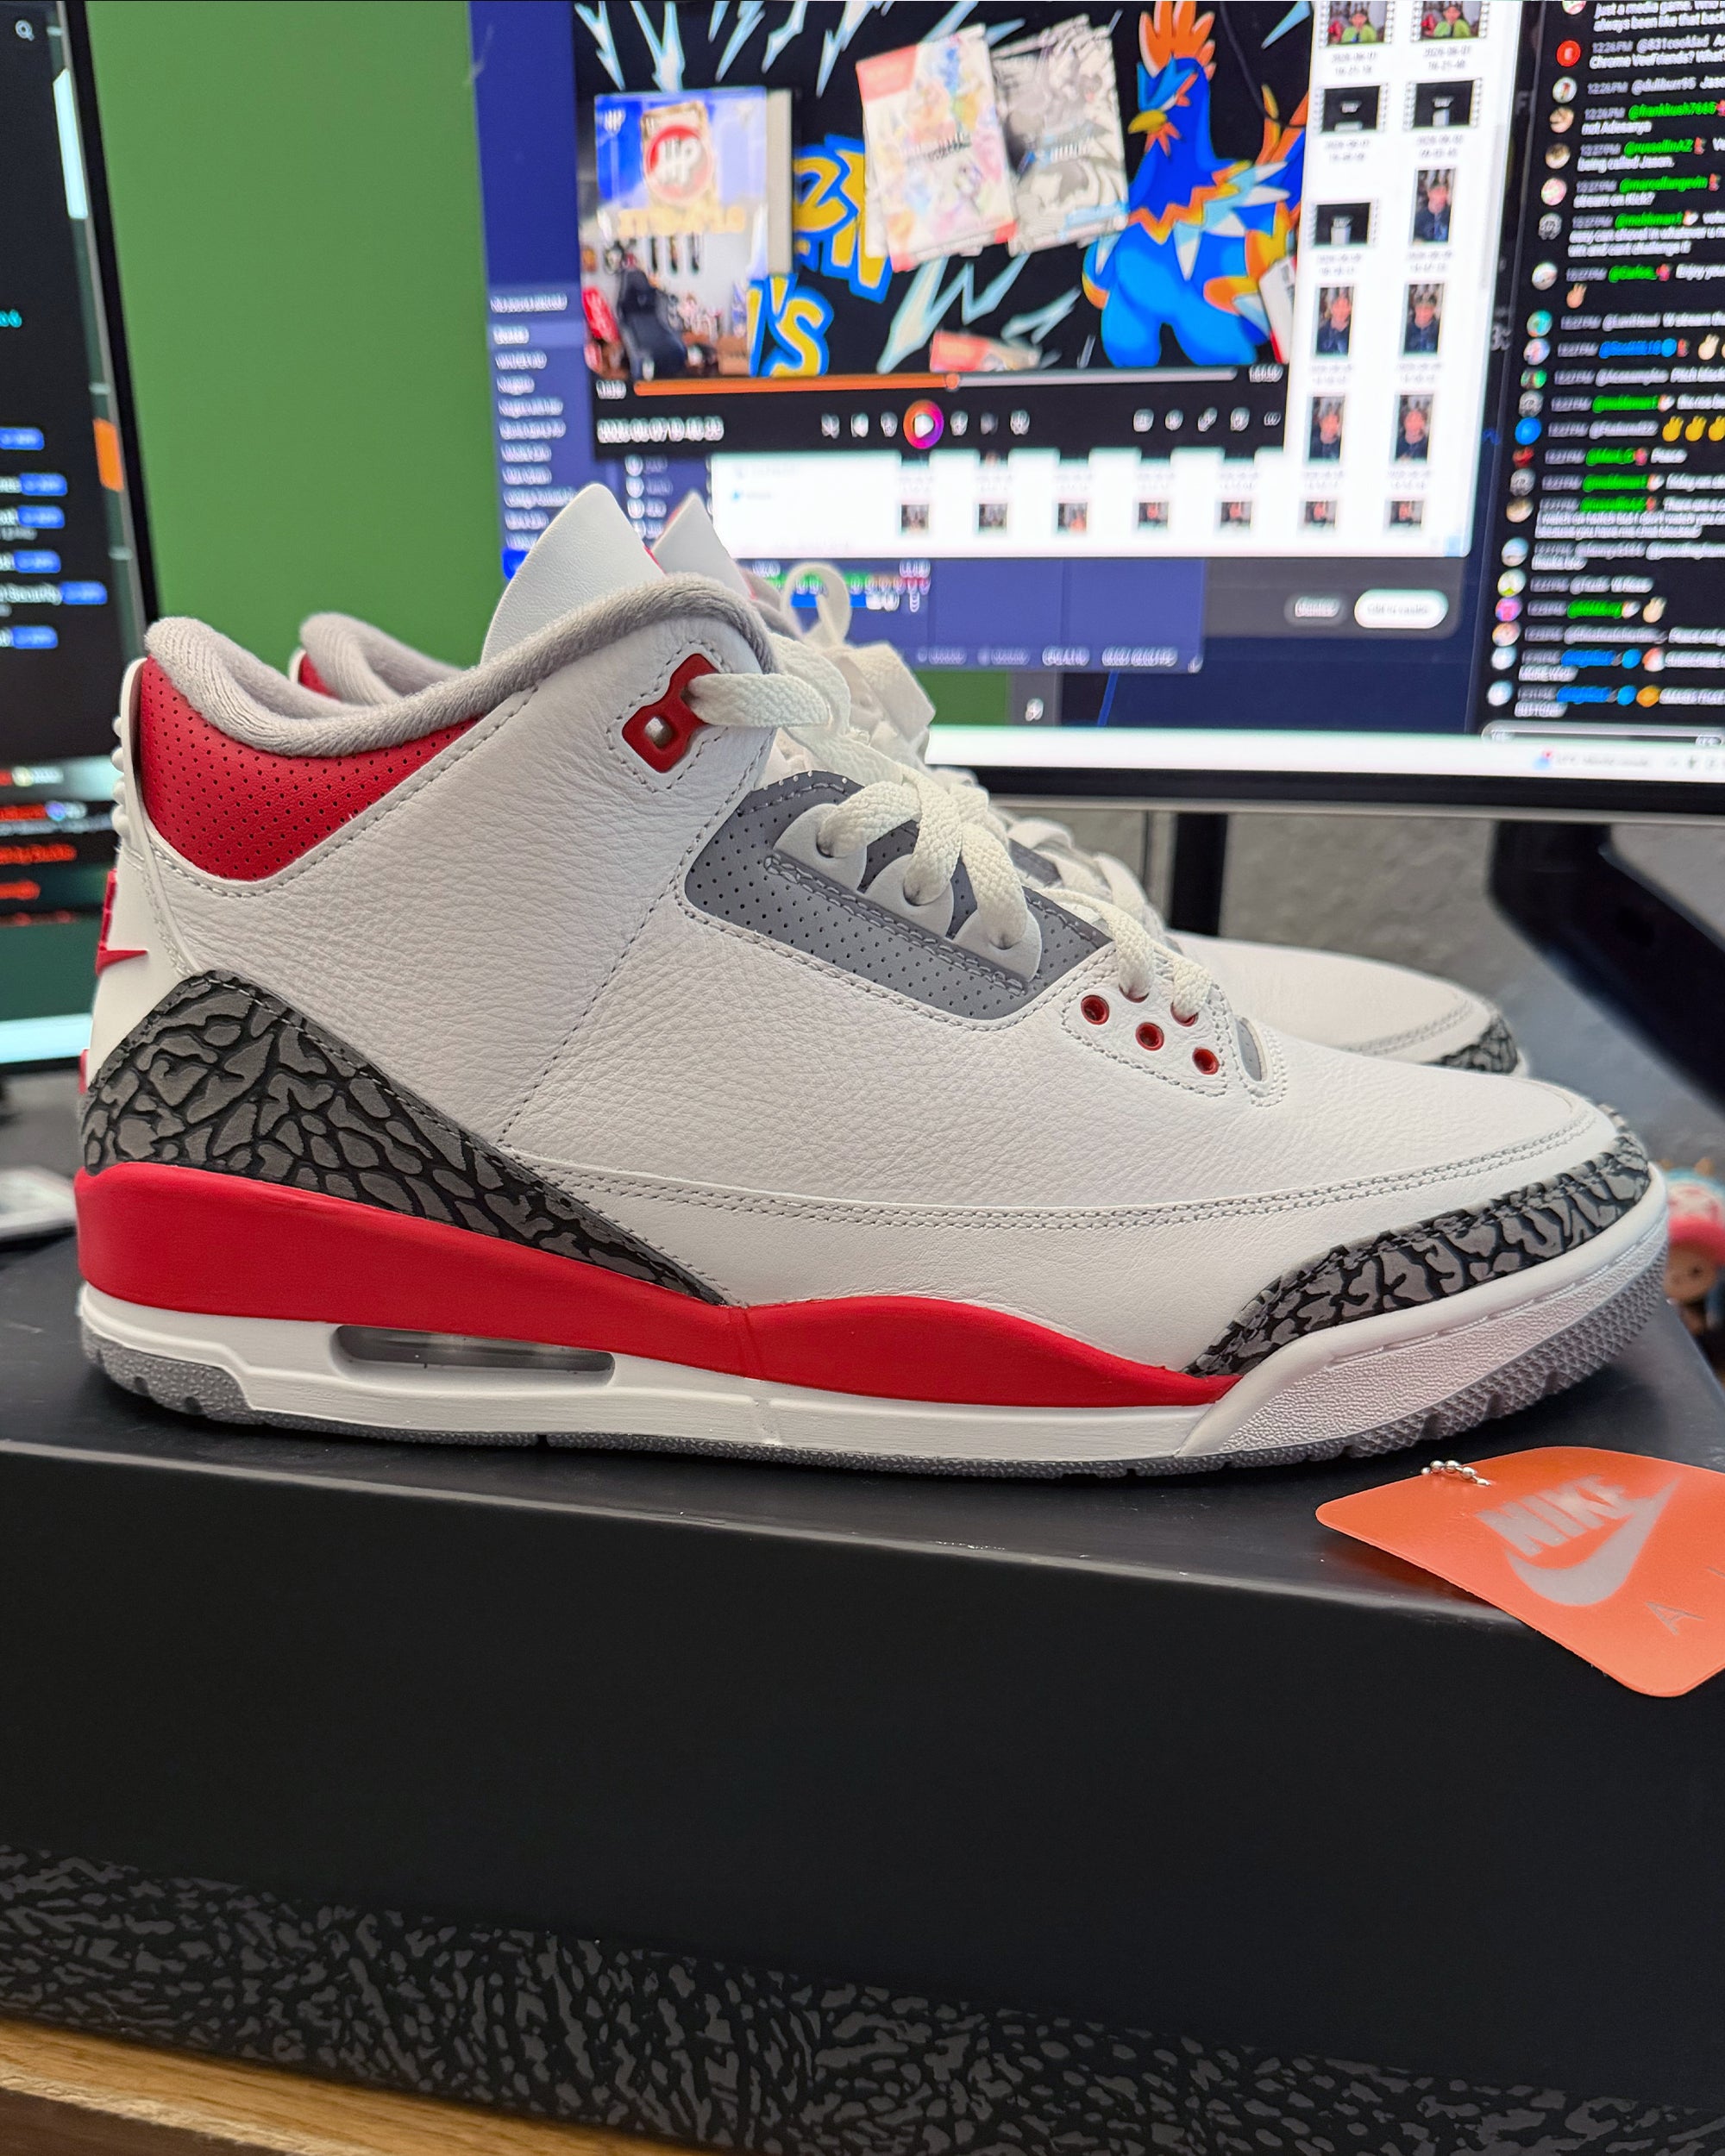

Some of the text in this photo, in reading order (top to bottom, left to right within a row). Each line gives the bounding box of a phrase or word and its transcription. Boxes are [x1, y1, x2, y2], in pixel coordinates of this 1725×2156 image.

[1594, 16, 1630, 33] always
[1631, 15, 1658, 29] been
[1659, 13, 1677, 28] like
[1678, 12, 1700, 27] that
[1474, 1473, 1640, 1557] NIKE
